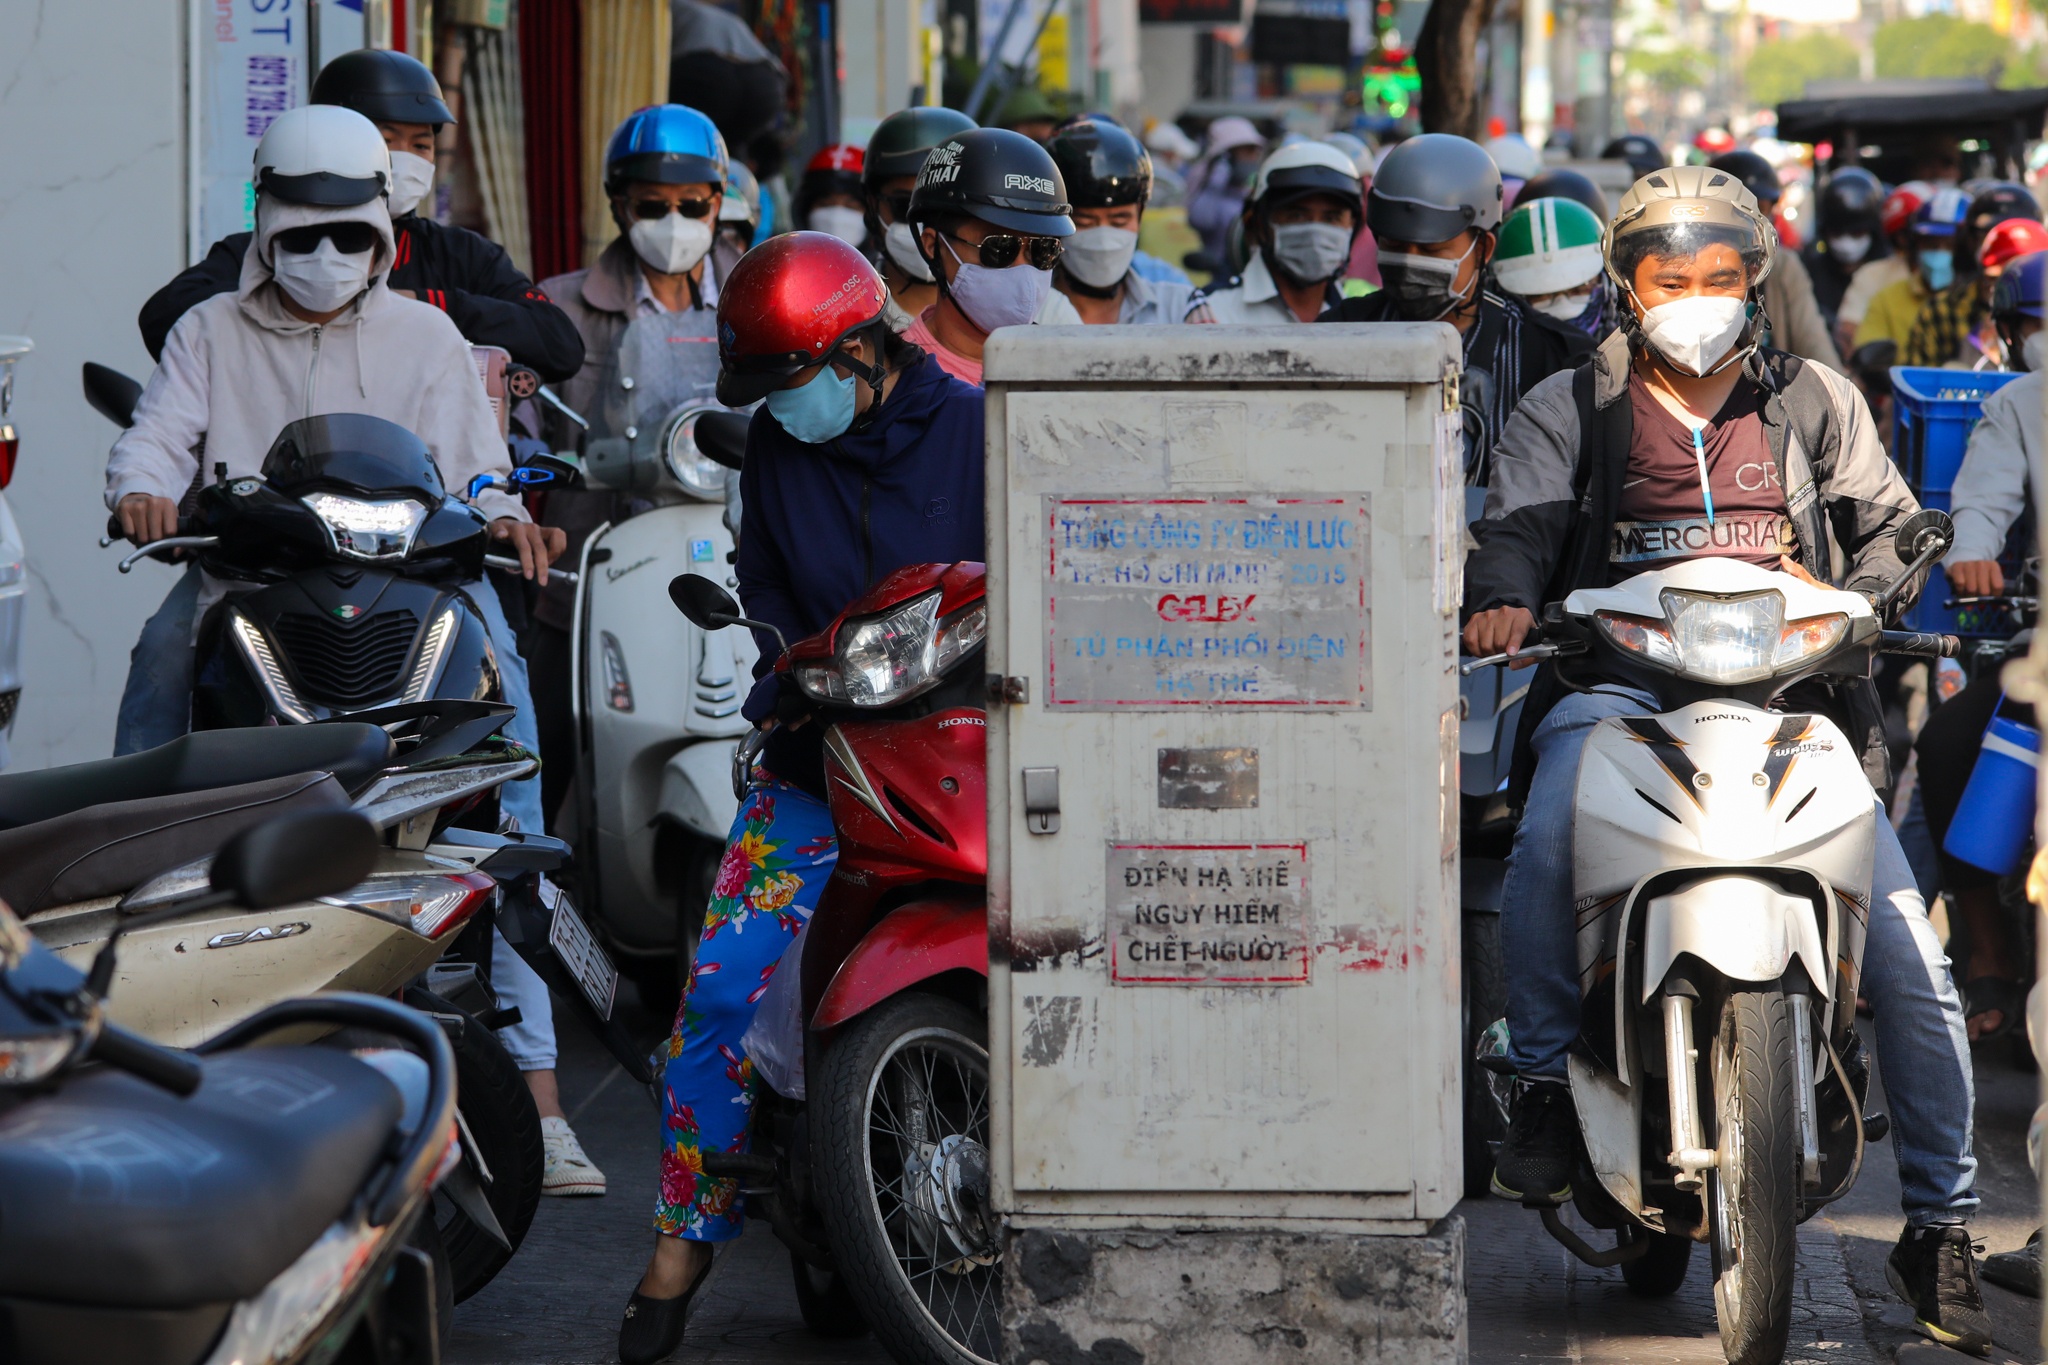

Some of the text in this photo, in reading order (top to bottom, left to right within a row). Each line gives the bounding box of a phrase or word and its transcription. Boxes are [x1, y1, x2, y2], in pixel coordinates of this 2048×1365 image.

[1004, 173, 1056, 196] AXE
[812, 290, 844, 316] Honda
[842, 274, 861, 293] OSC
[1292, 563, 1346, 584] 2015
[938, 717, 987, 730] HOND
[1694, 714, 1752, 725] HONDA
[836, 868, 869, 888] HONDA
[1198, 867, 1232, 893] HẠ
[1136, 904, 1206, 925] NGUY
[1128, 934, 1288, 962] CHẾT NGƯỜI
